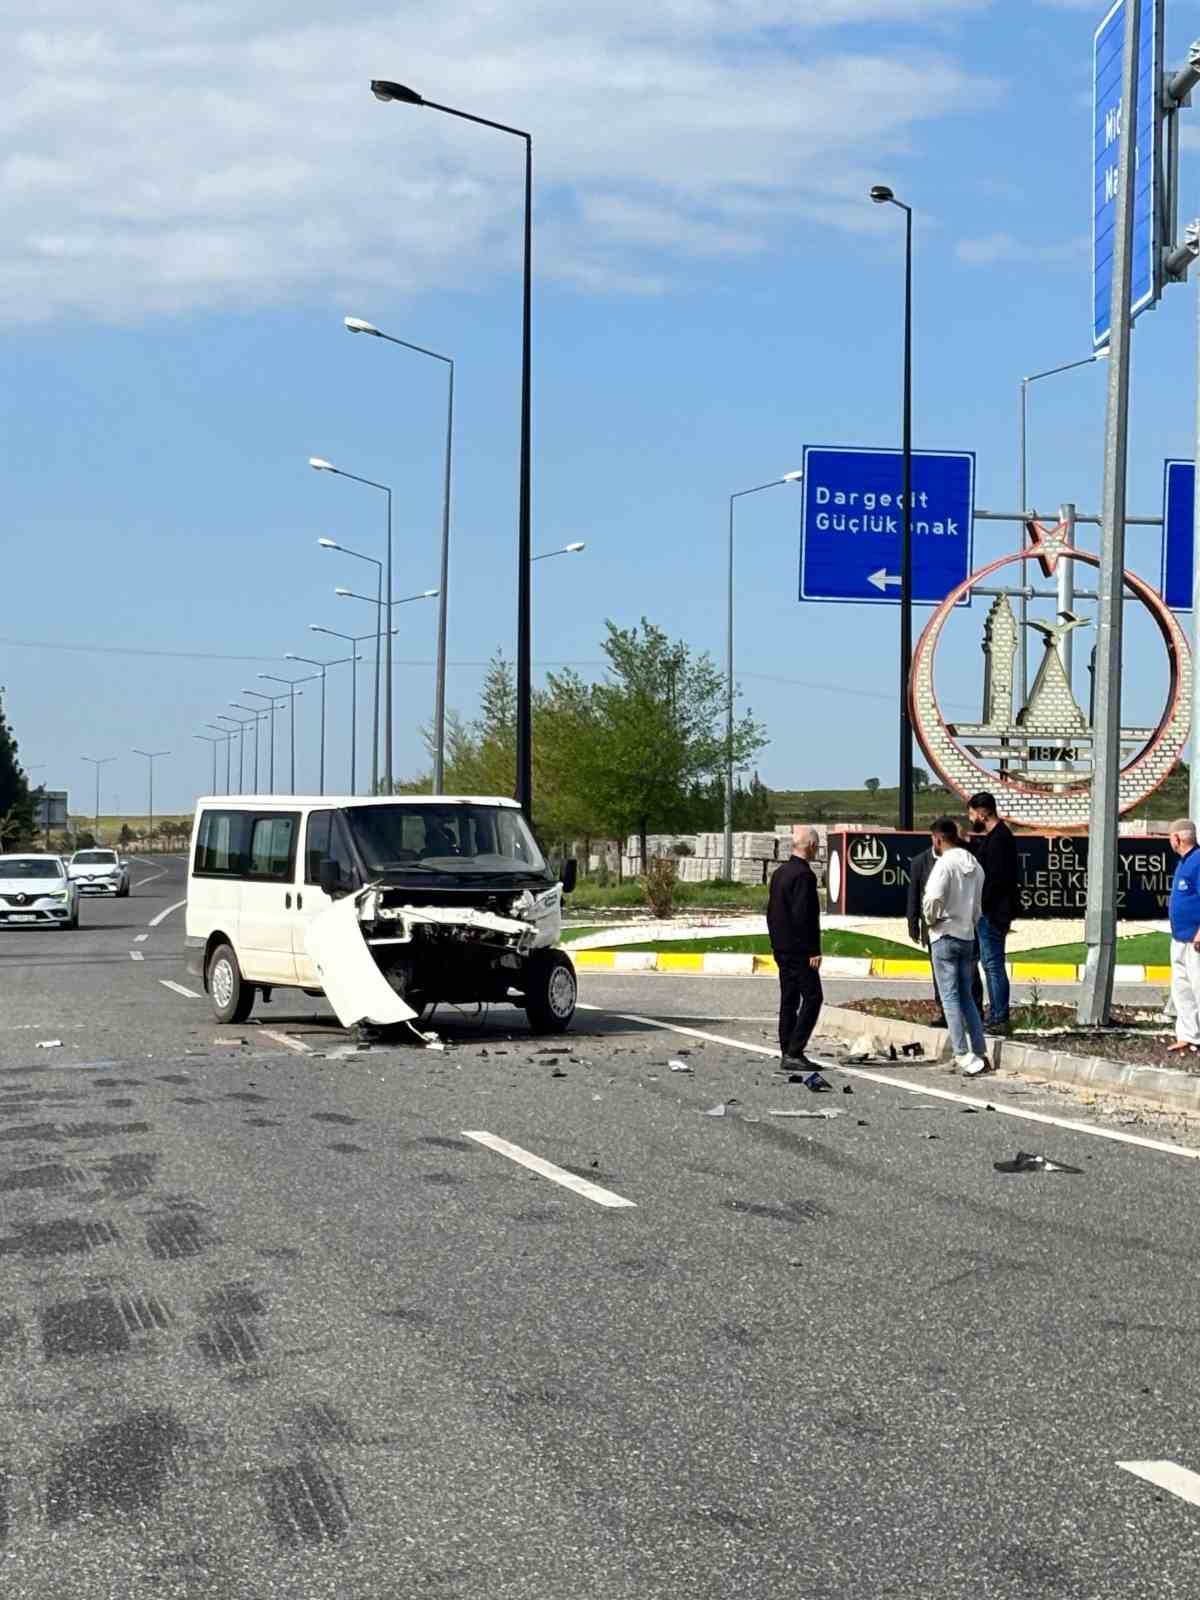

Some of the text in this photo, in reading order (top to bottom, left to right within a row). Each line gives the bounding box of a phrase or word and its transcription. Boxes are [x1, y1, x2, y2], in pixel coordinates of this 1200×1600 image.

[816, 512, 958, 535] Güçlüknak
[1033, 746, 1076, 761] 1873
[1047, 852, 1167, 871] BELYESİ
